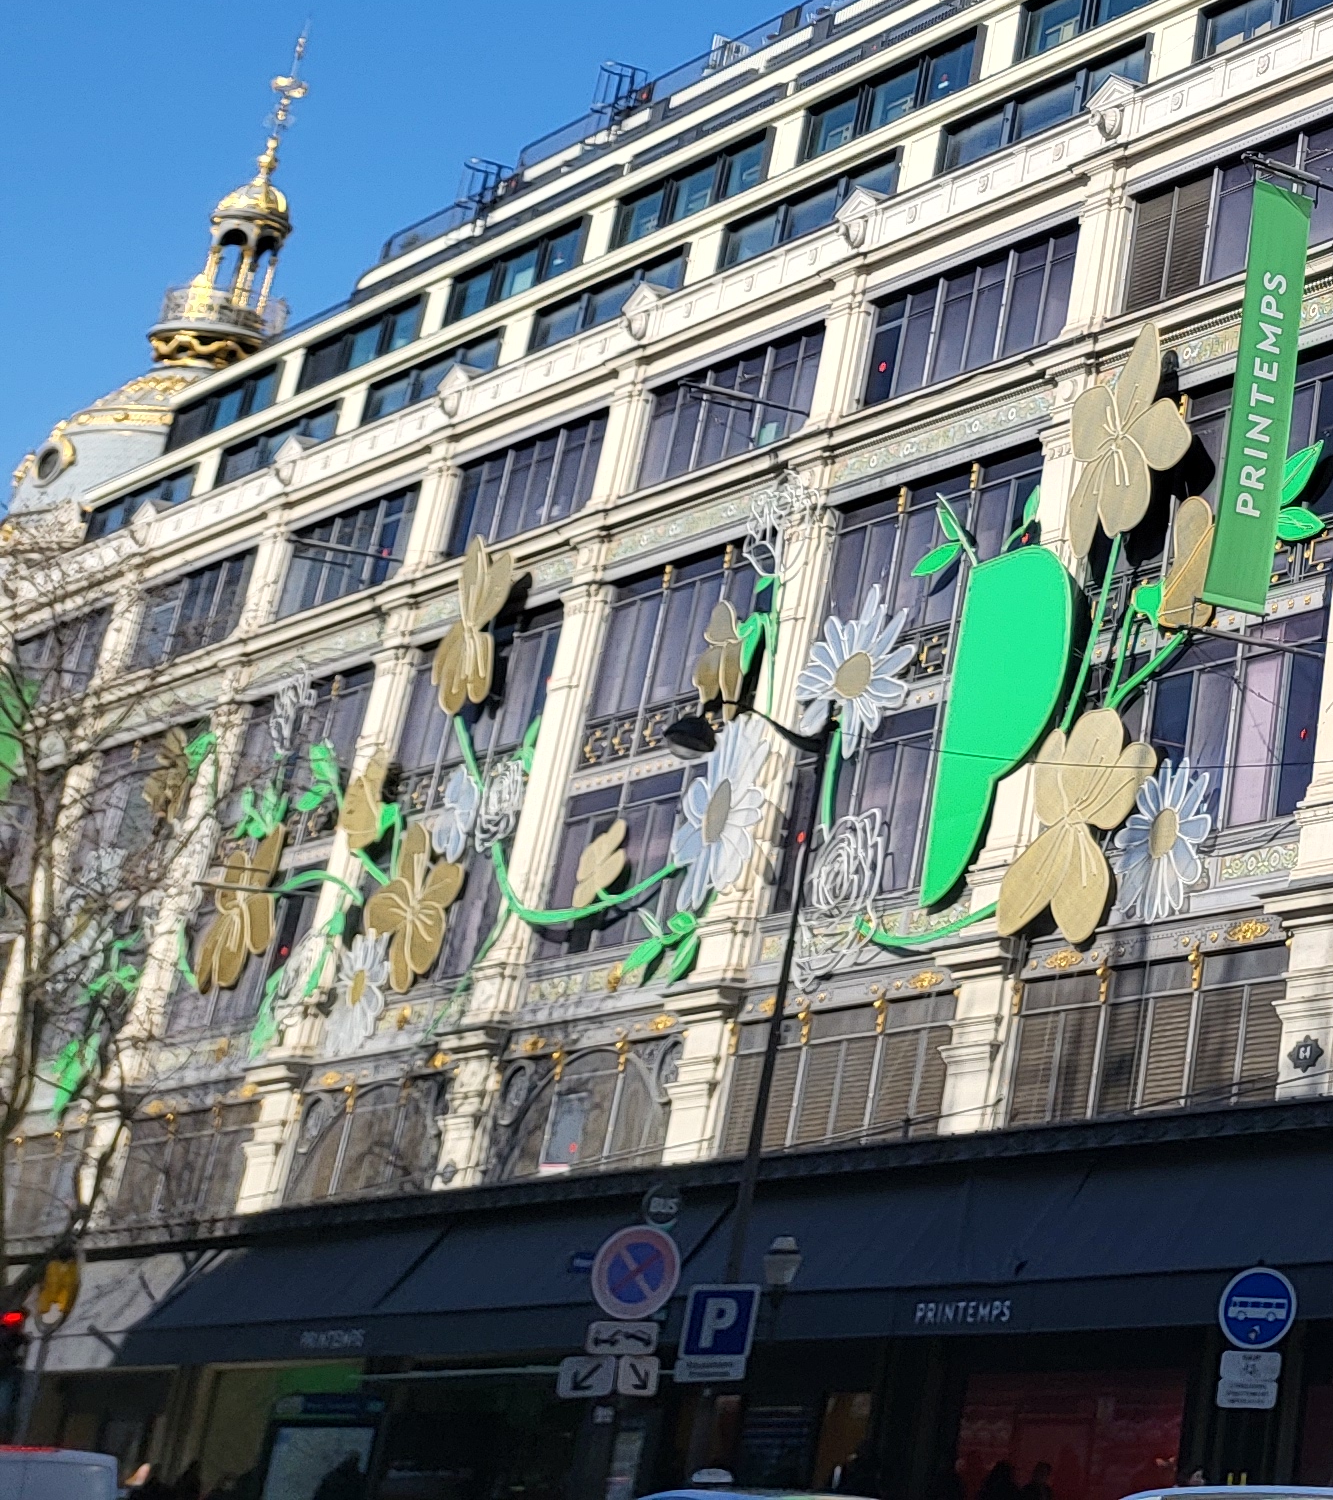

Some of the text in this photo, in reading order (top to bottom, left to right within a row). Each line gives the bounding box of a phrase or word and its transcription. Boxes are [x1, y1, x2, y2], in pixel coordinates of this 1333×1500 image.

[1235, 270, 1288, 518] PRINTEMPS
[698, 1297, 738, 1349] P
[914, 1300, 1011, 1324] PRINTEMPS
